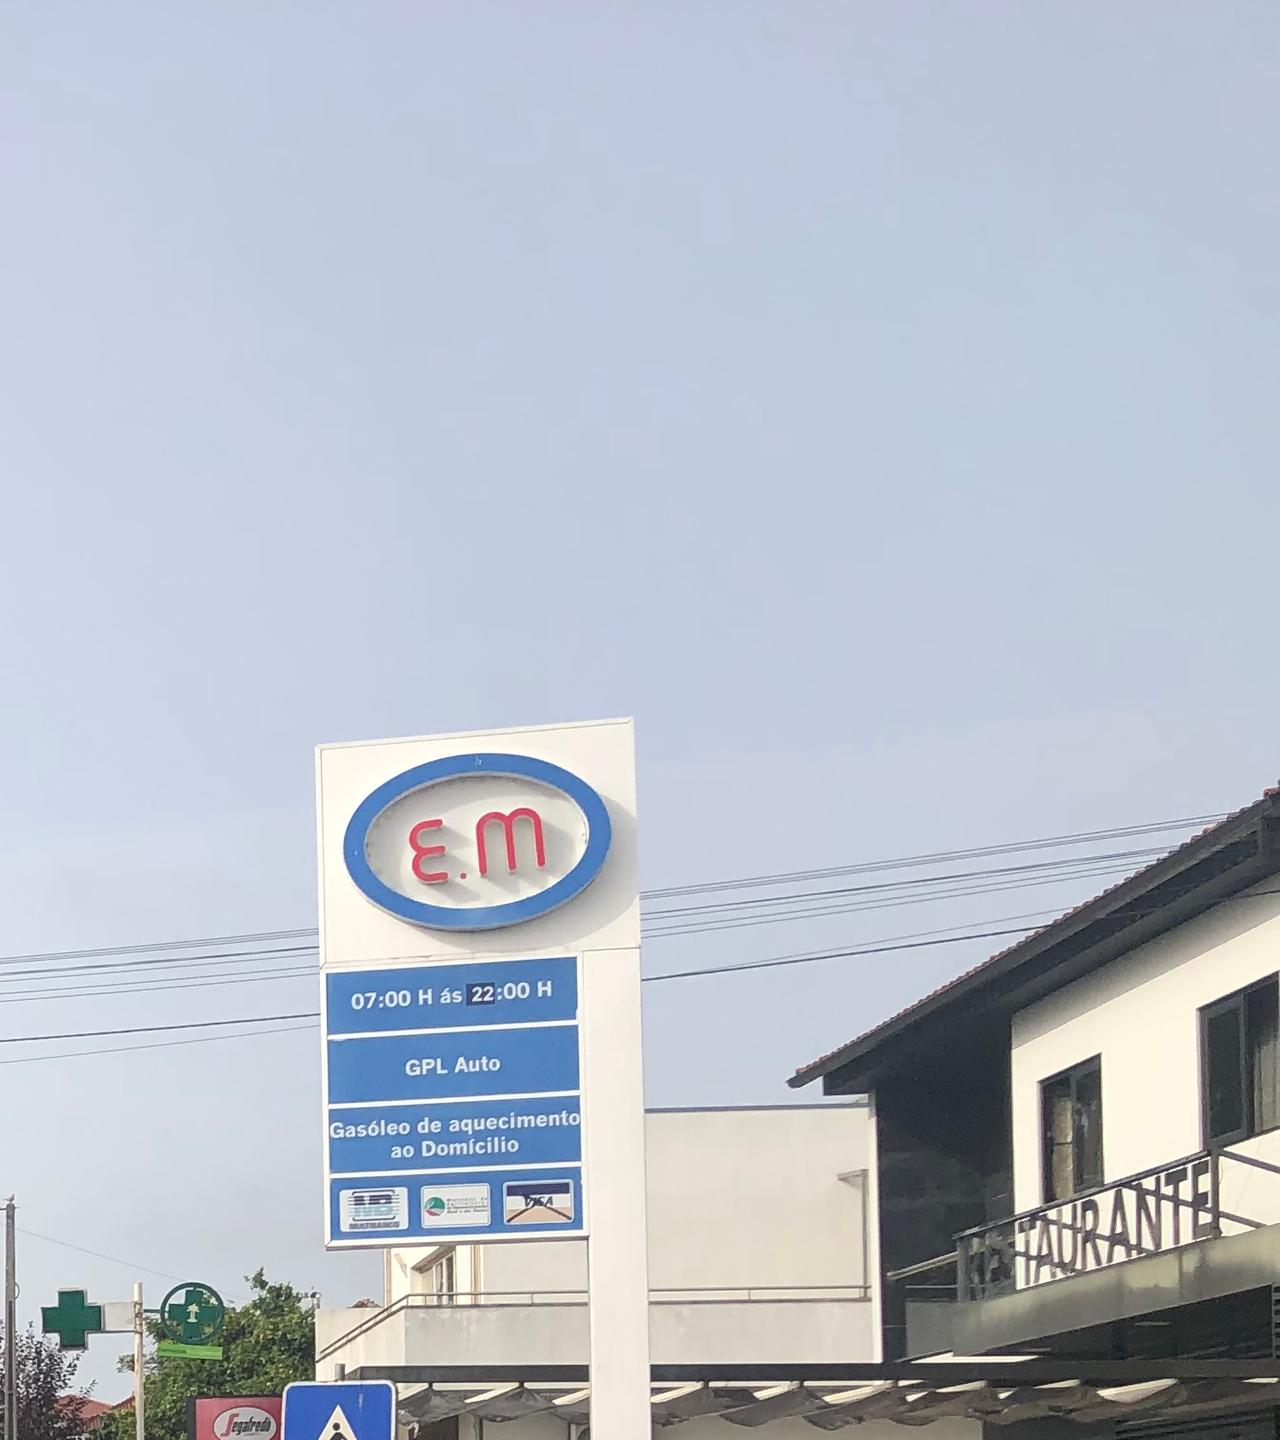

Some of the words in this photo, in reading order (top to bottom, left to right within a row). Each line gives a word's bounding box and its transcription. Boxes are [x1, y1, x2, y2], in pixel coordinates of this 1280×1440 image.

[351, 990, 411, 1010] 07:00
[418, 988, 432, 1006] H
[440, 987, 463, 1004] ás
[471, 981, 530, 1003] 22:00
[537, 980, 552, 998] H
[405, 1058, 448, 1077] GPL
[454, 1055, 501, 1074] Auto
[329, 1119, 410, 1139] Gasóleo
[417, 1116, 441, 1134] de
[448, 1110, 580, 1135] aquecimento
[391, 1144, 415, 1159] ao
[421, 1136, 520, 1157] Domícilio
[219, 1412, 272, 1437] Segafredo
